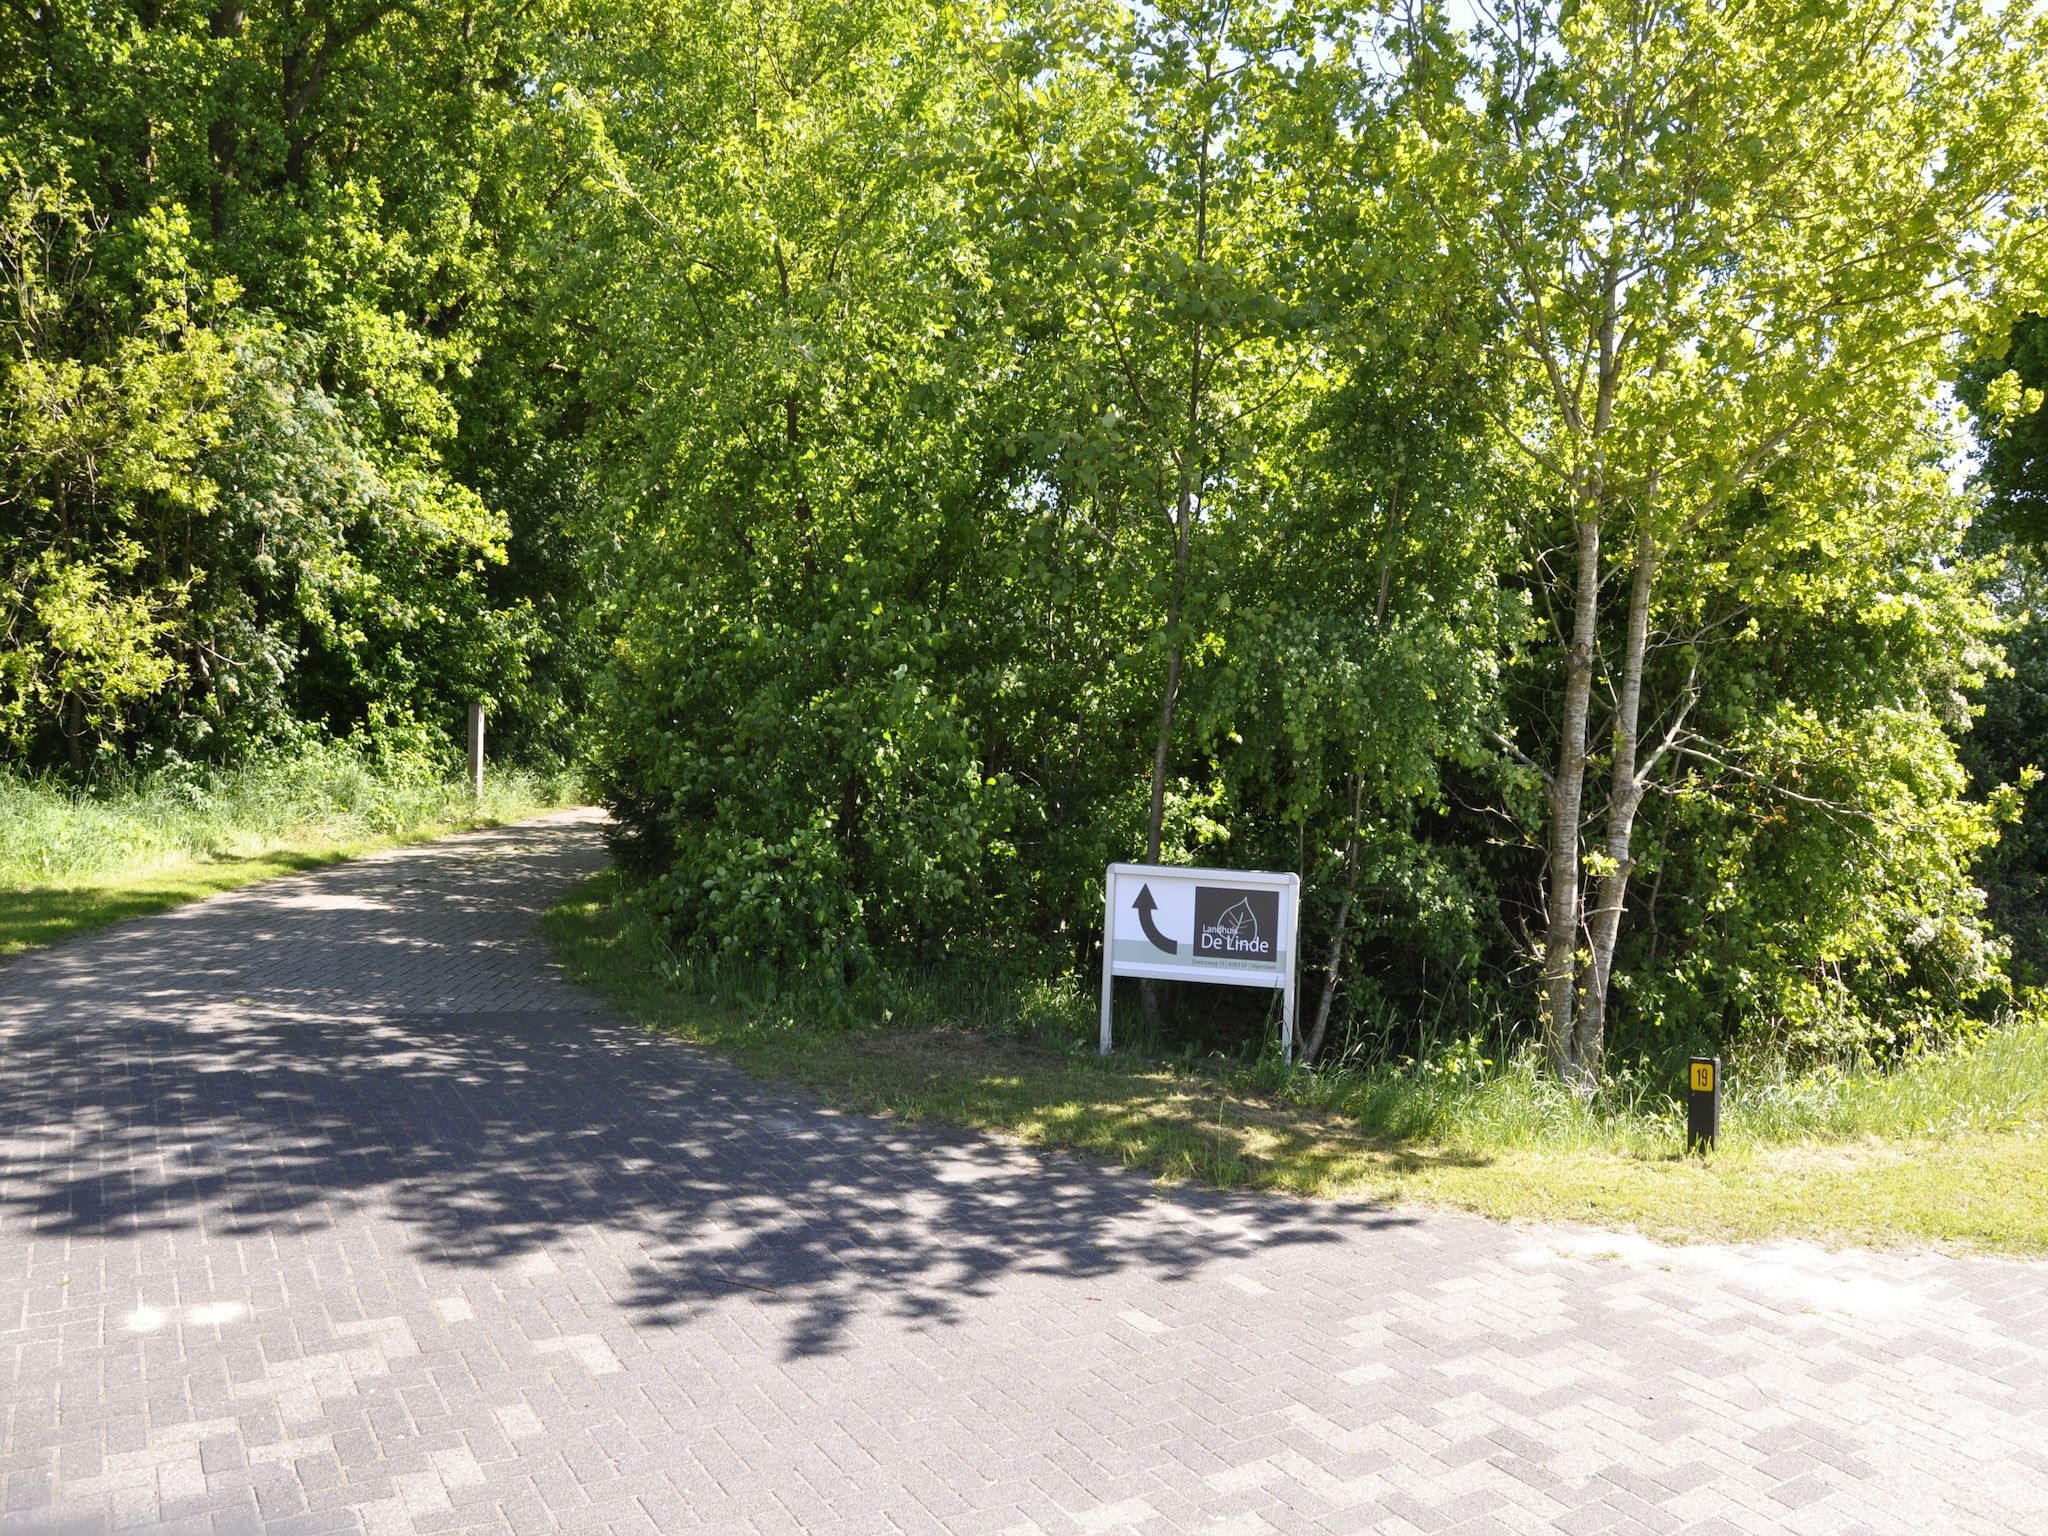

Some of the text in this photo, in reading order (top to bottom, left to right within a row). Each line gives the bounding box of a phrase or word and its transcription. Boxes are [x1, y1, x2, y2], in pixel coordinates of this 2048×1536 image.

[1202, 924, 1238, 935] Landhuis
[1201, 933, 1269, 953] De Linde
[1696, 1068, 1708, 1087] 19
